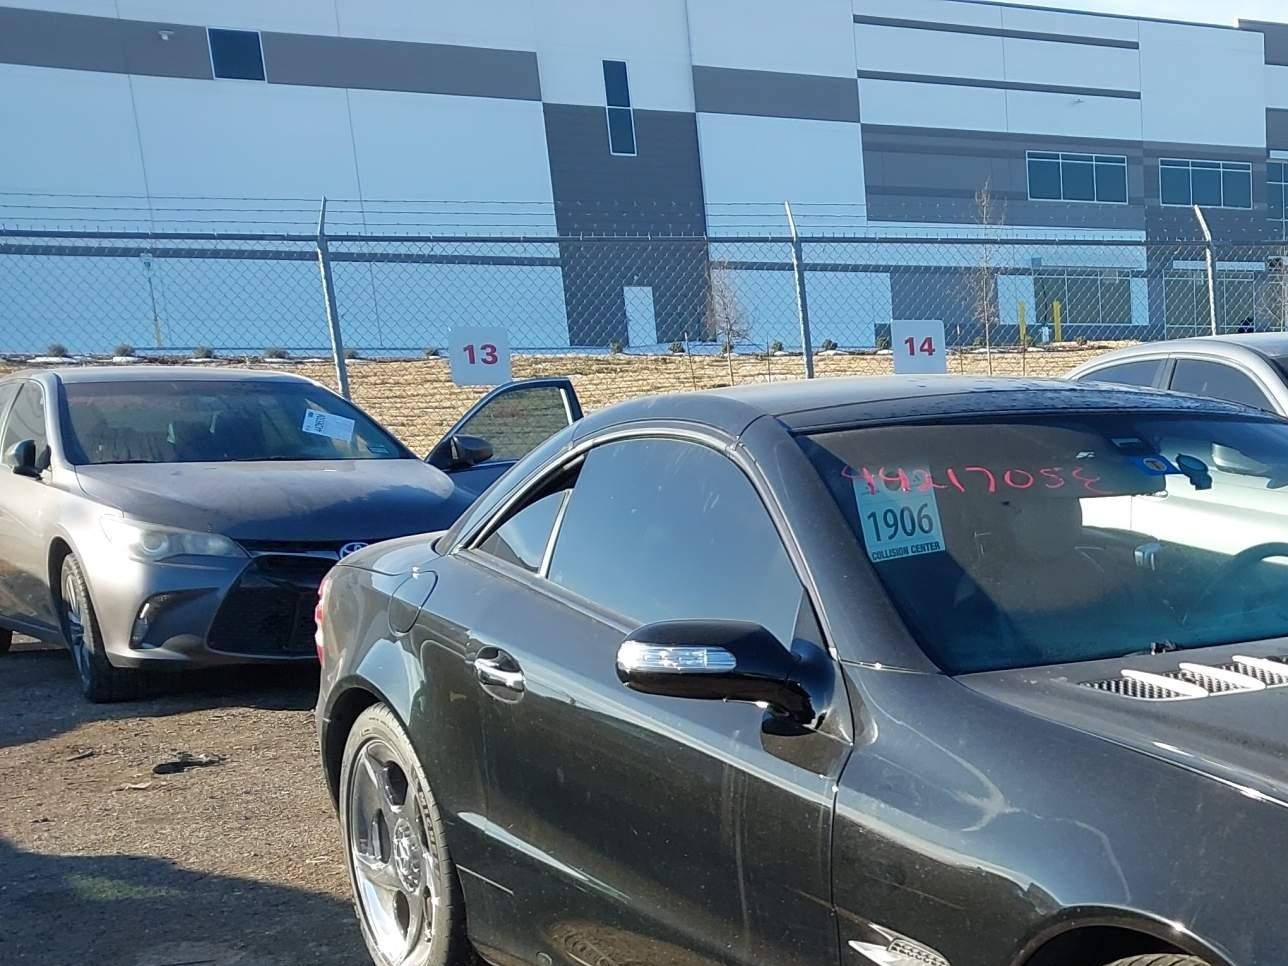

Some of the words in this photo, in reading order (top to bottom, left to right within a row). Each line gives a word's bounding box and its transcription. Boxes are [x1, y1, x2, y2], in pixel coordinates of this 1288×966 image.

[463, 343, 498, 365] 13
[904, 336, 936, 356] 14
[866, 502, 934, 543] 1906
[871, 544, 910, 562] COLLISION
[909, 541, 941, 555] CENTER
